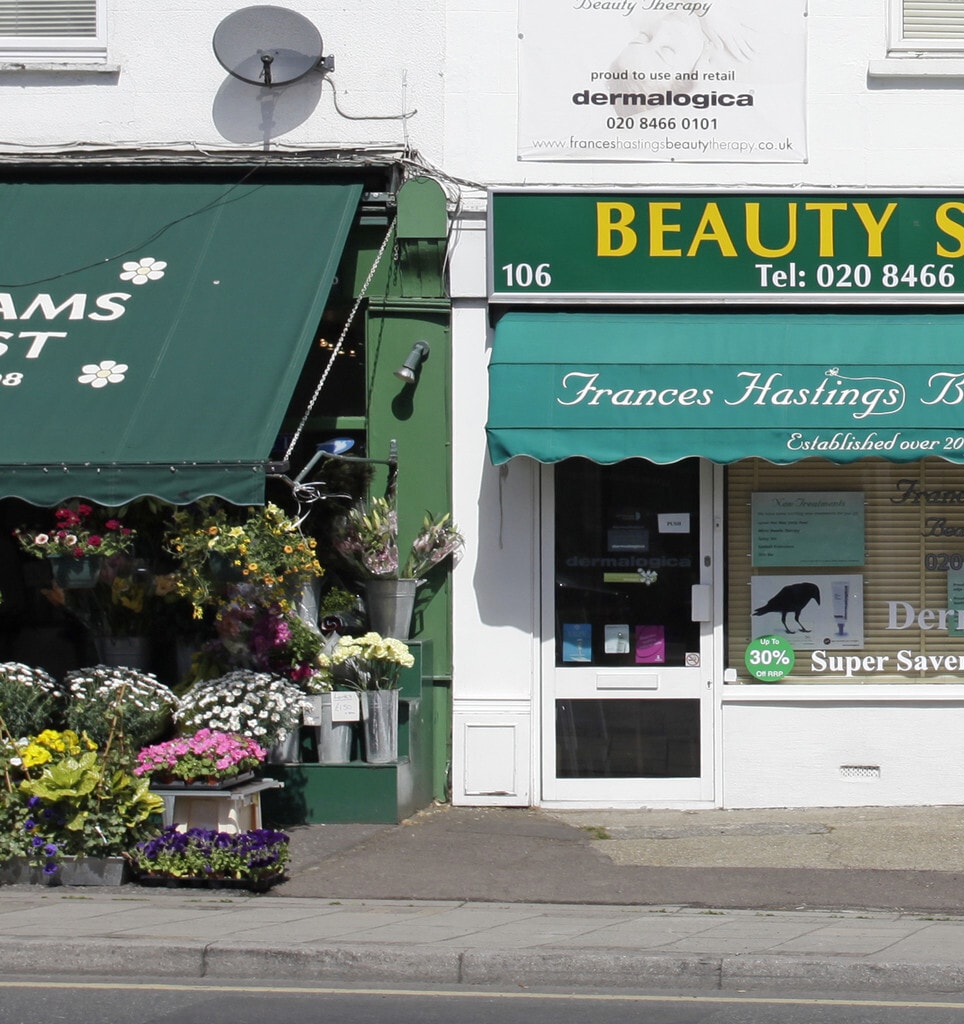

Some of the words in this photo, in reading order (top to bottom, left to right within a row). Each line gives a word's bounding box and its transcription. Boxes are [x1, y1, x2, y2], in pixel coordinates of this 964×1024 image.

[590, 70, 628, 82] proud
[633, 71, 646, 81] to
[650, 72, 671, 81] use
[675, 70, 698, 81] and
[703, 70, 735, 81] retail
[572, 89, 754, 108] dermalogica
[606, 117, 634, 129] 020
[639, 117, 676, 129] 8466
[681, 117, 718, 129] 0101
[532, 136, 793, 153] www.franceshastingsbeautytherapy.co.uk
[596, 201, 898, 258] BEAUTY
[502, 263, 552, 287] 106
[755, 264, 806, 288] Tel:
[816, 264, 871, 288] 020
[882, 264, 955, 288] 8466
[556, 371, 713, 407] Frances
[724, 370, 902, 419] Hastings
[786, 432, 901, 451] Established
[900, 440, 940, 451] over
[943, 437, 964, 450] 20
[566, 556, 691, 568] dermalogica
[924, 553, 963, 570] 020
[760, 638, 770, 646] Up
[750, 649, 790, 665] 30%
[811, 650, 888, 676] Super
